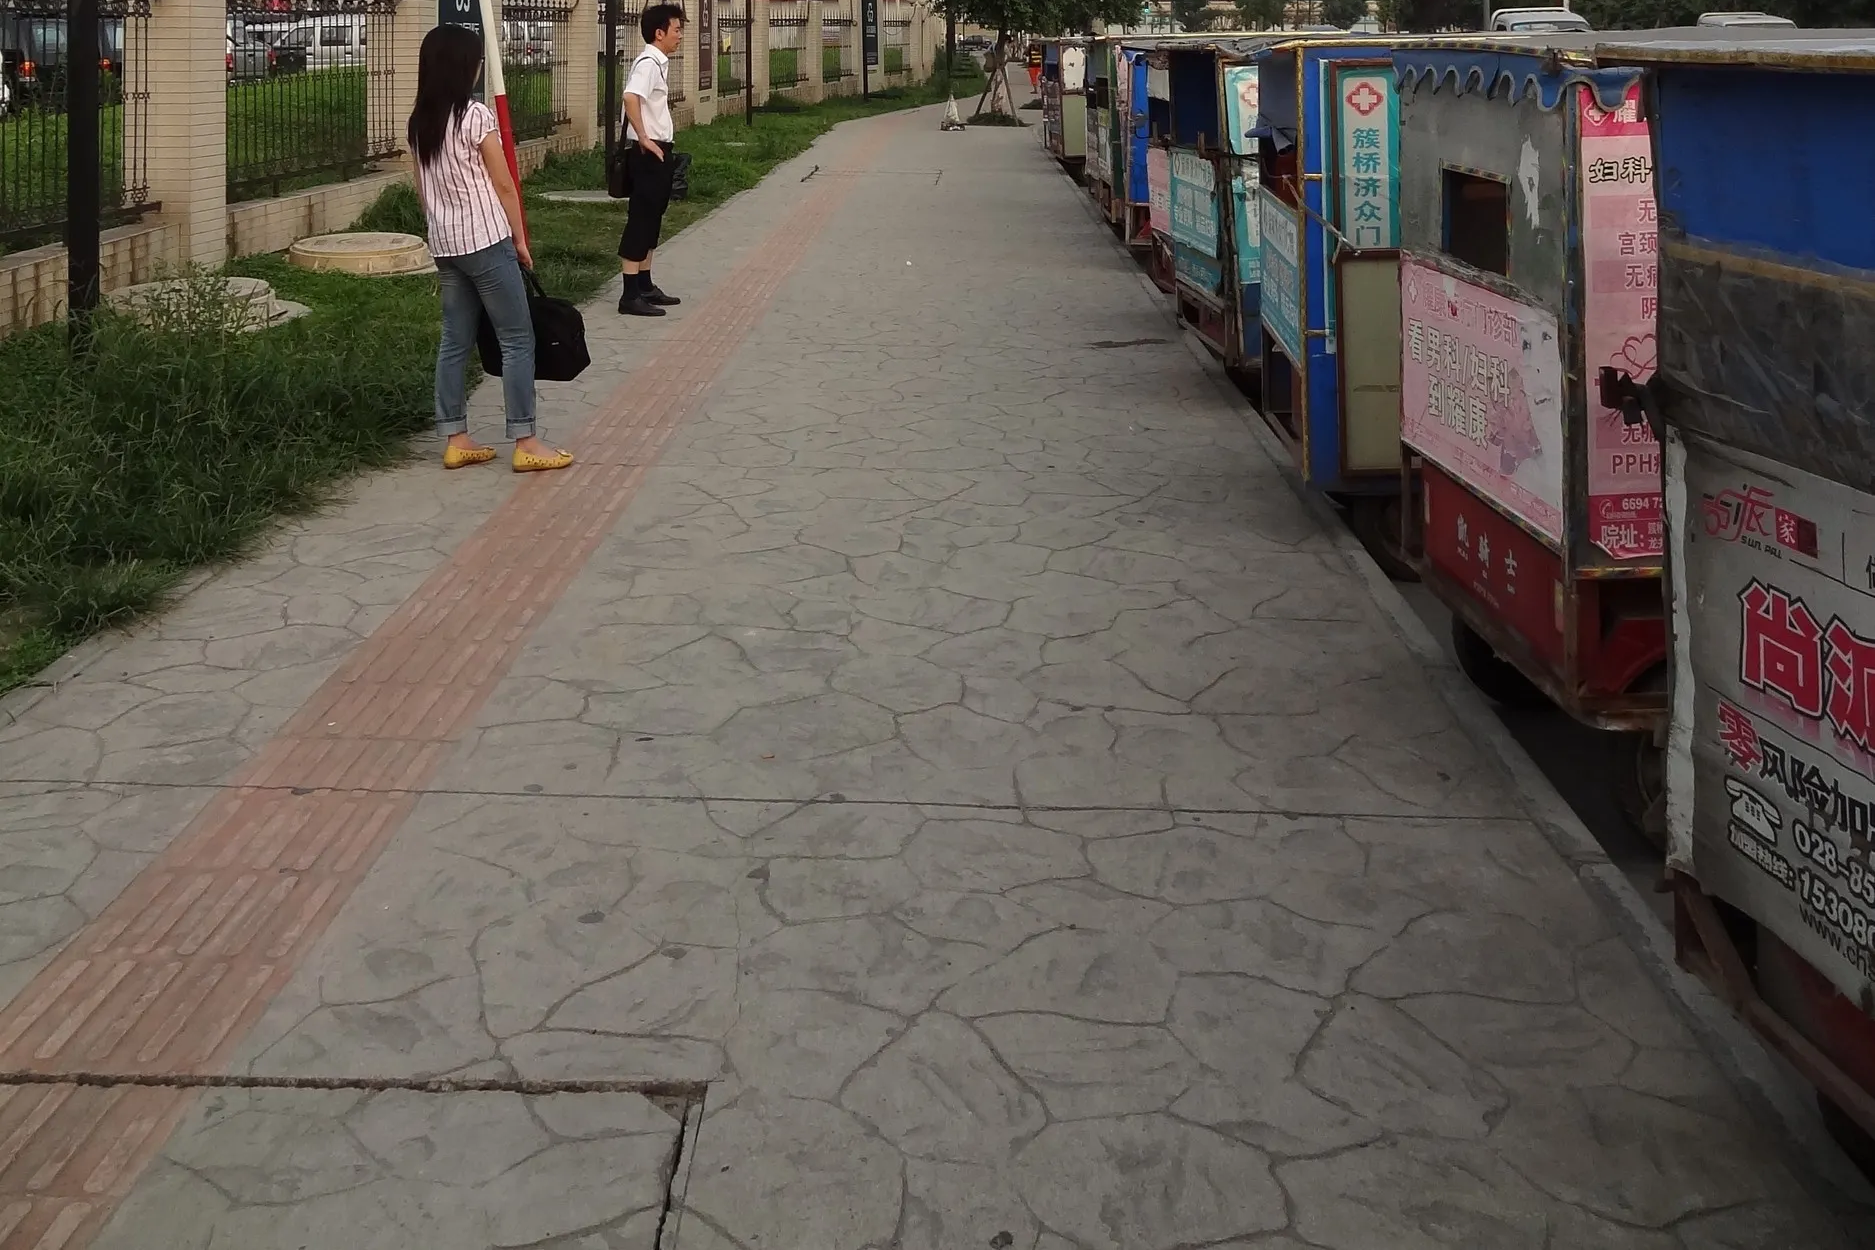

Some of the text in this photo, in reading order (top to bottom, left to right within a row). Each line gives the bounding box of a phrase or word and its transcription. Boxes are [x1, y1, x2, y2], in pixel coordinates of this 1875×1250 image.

[1588, 156, 1652, 184] 妇科
[1352, 128, 1382, 247] 簇桥济众门
[1618, 231, 1658, 257] 宫颈
[1622, 497, 1649, 510] 6694
[1717, 698, 1875, 842] 零风险加
